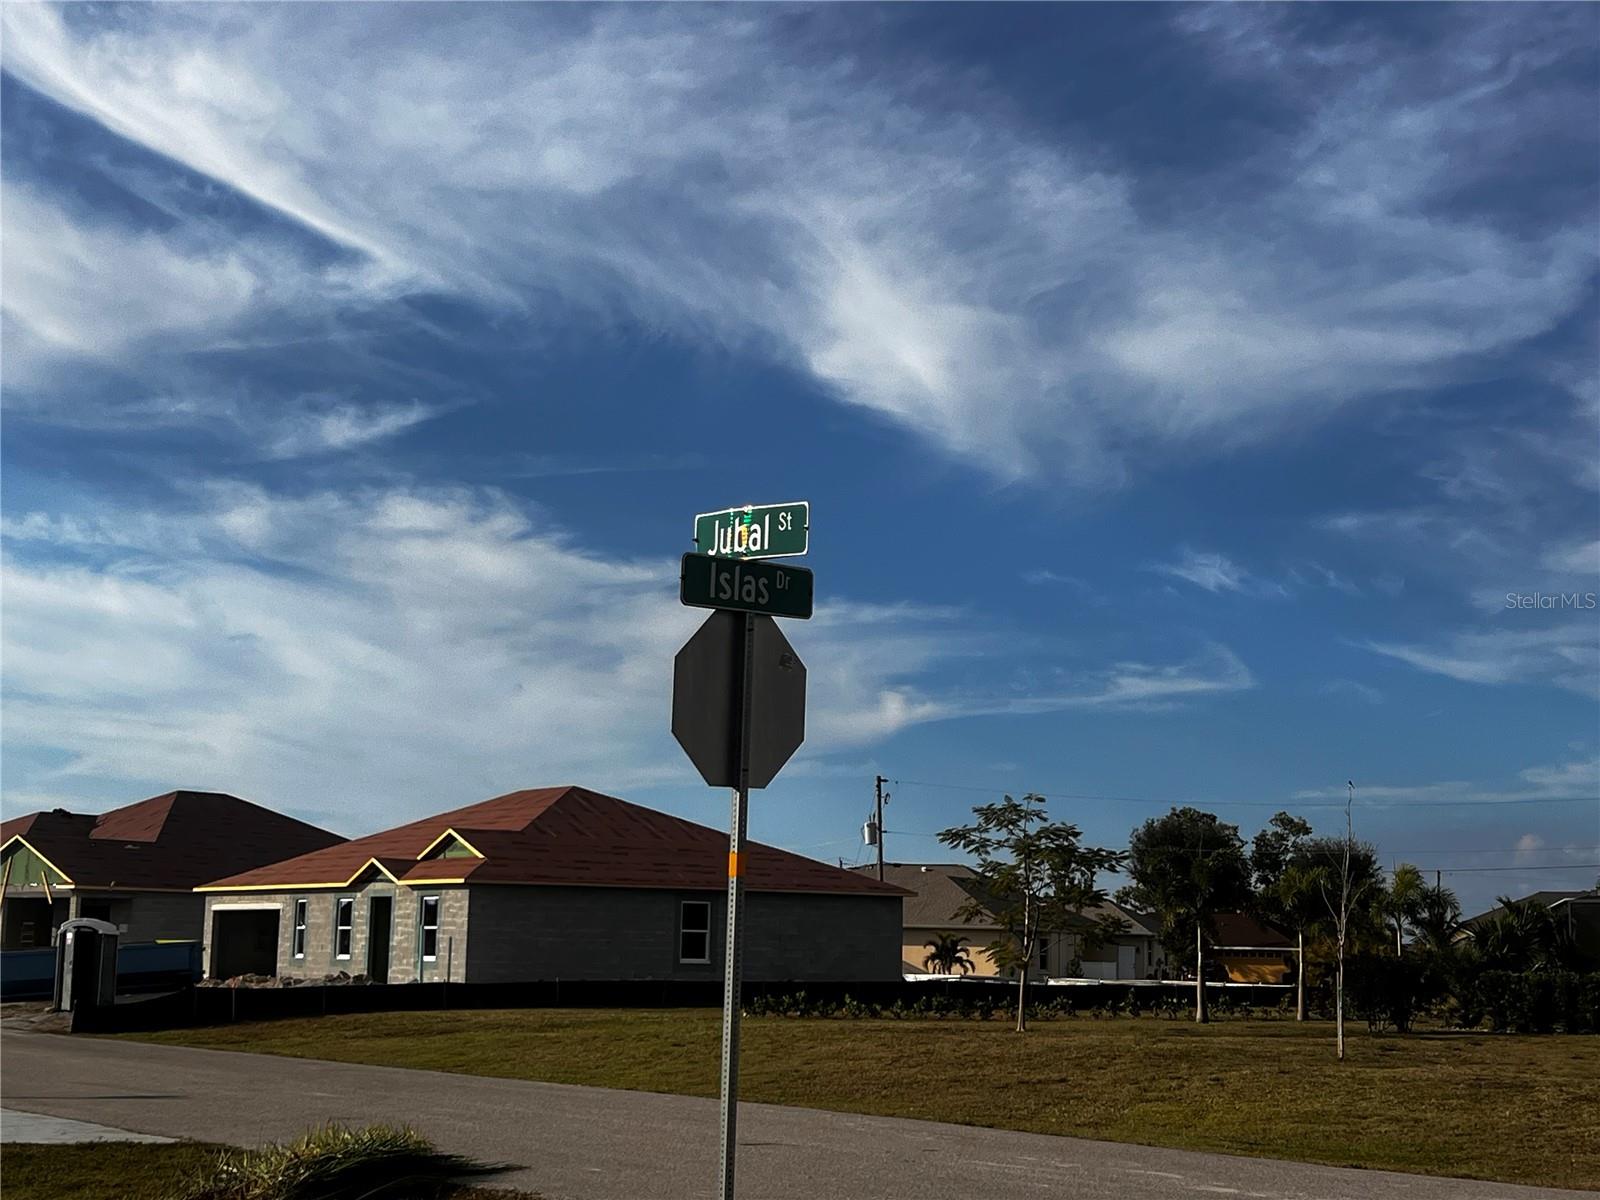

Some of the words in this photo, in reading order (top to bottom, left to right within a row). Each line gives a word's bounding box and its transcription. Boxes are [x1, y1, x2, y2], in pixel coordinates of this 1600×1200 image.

[708, 514, 769, 556] Jubal
[778, 511, 792, 531] St
[710, 562, 769, 605] Islas
[776, 570, 791, 590] Dr
